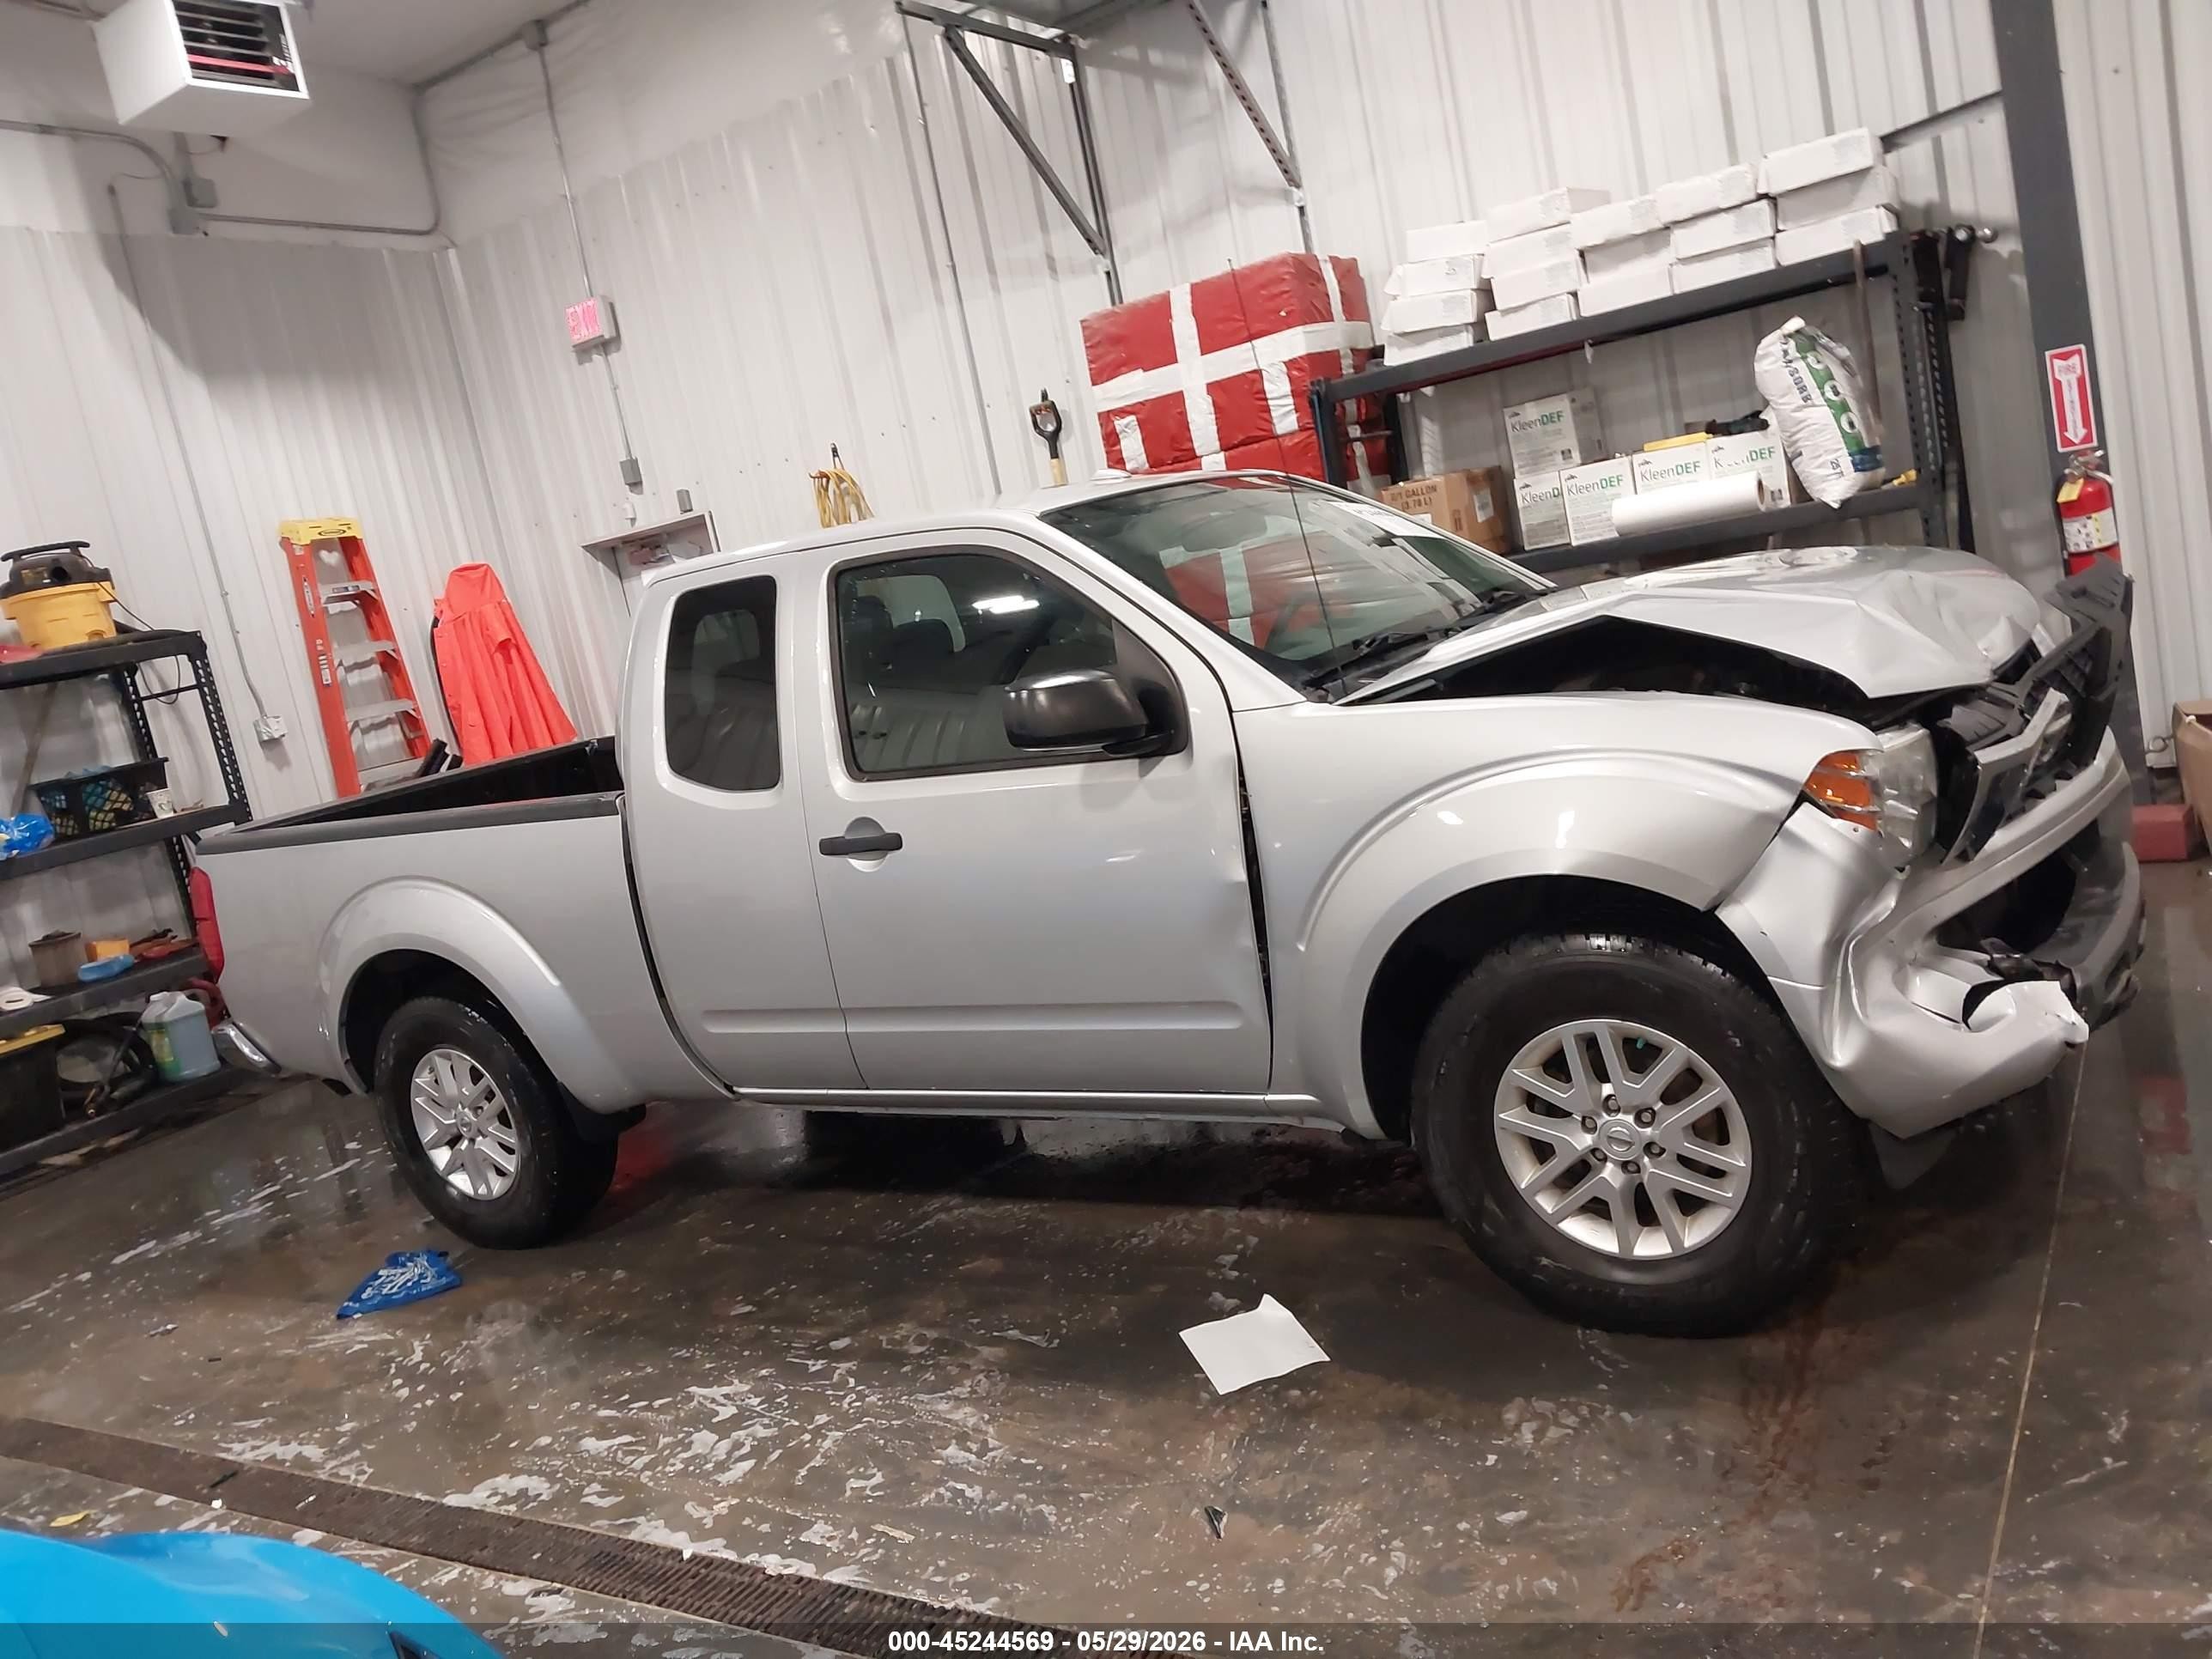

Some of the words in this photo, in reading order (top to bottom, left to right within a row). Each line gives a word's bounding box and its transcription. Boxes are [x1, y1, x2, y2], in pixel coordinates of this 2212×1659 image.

[1510, 410, 1565, 433] KleenDEF
[1640, 460, 1701, 483] KleenDEF
[1405, 484, 1437, 498] GALLON
[1566, 474, 1623, 496] KleenDEF
